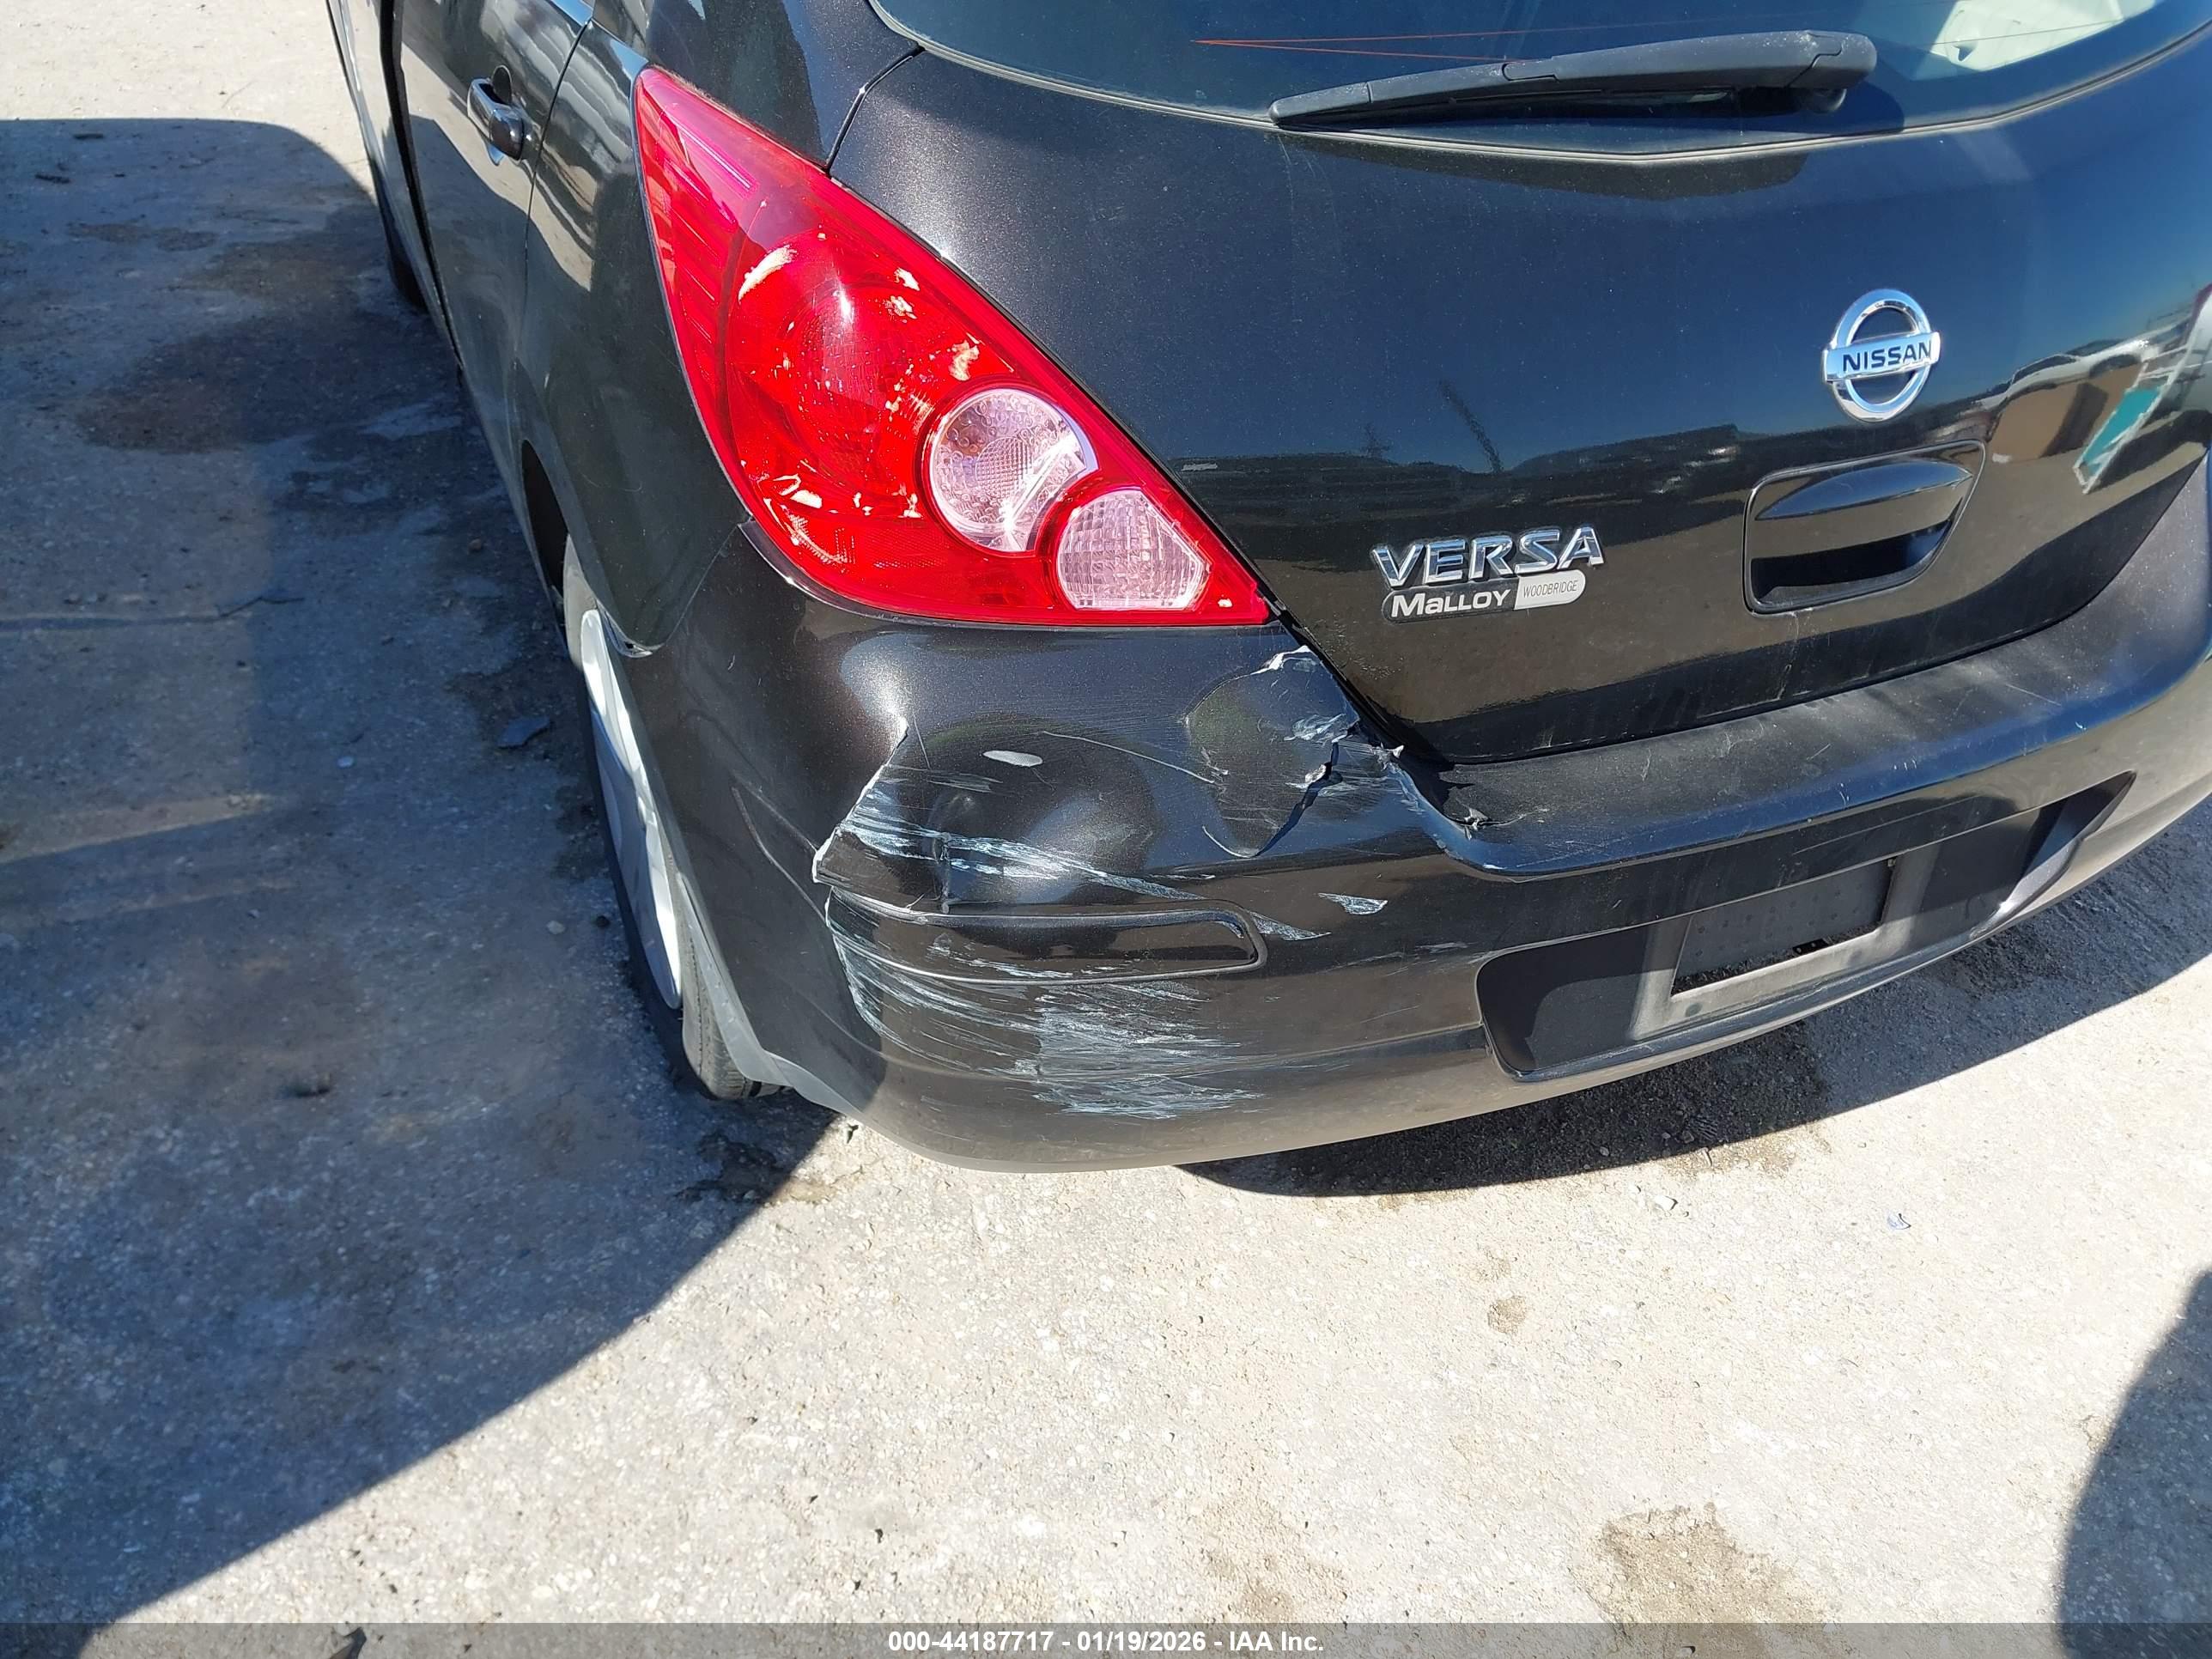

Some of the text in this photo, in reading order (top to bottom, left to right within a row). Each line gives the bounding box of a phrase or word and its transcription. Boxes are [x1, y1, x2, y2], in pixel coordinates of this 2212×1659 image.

[1842, 339, 1932, 372] NISSAN
[1371, 526, 1605, 587] VERSA
[1523, 580, 1579, 598] WOODBRIDGE
